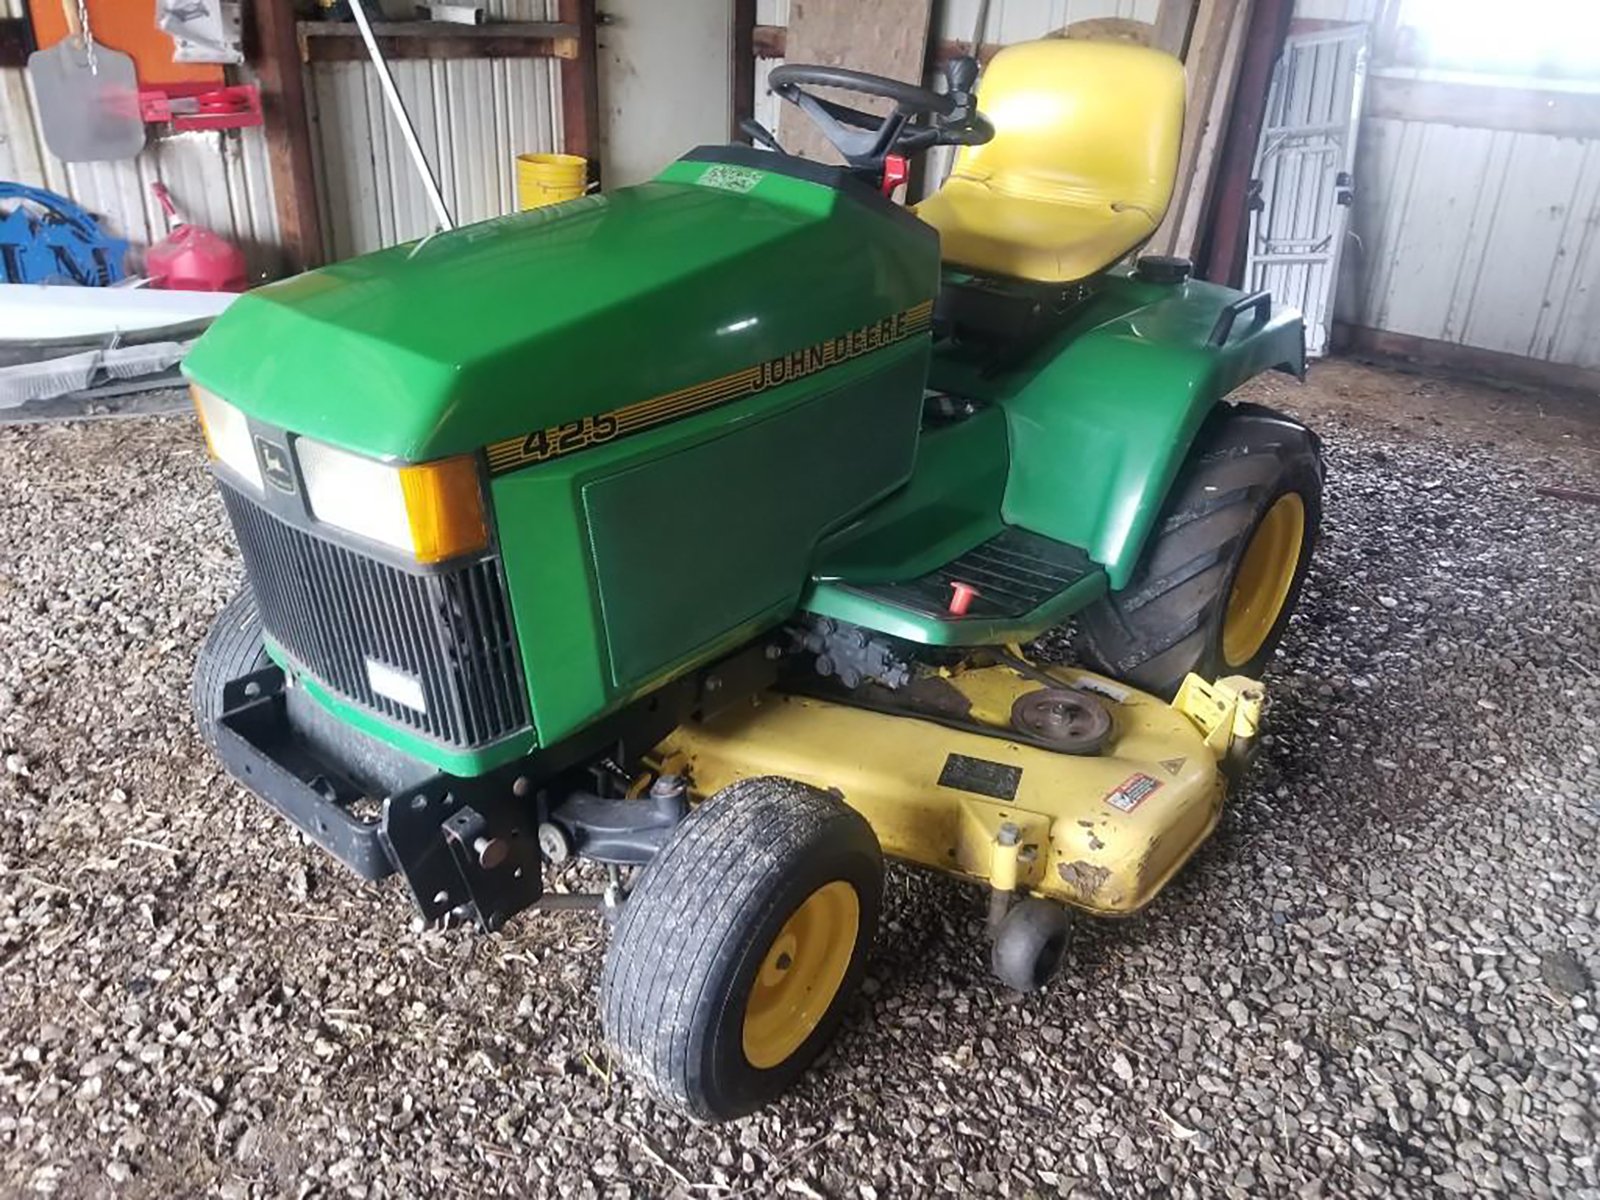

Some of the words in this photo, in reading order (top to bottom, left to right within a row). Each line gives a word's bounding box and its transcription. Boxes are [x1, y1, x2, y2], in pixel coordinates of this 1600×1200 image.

[751, 344, 825, 392] JOHN
[832, 311, 908, 365] DEERE
[521, 410, 618, 460] 425
